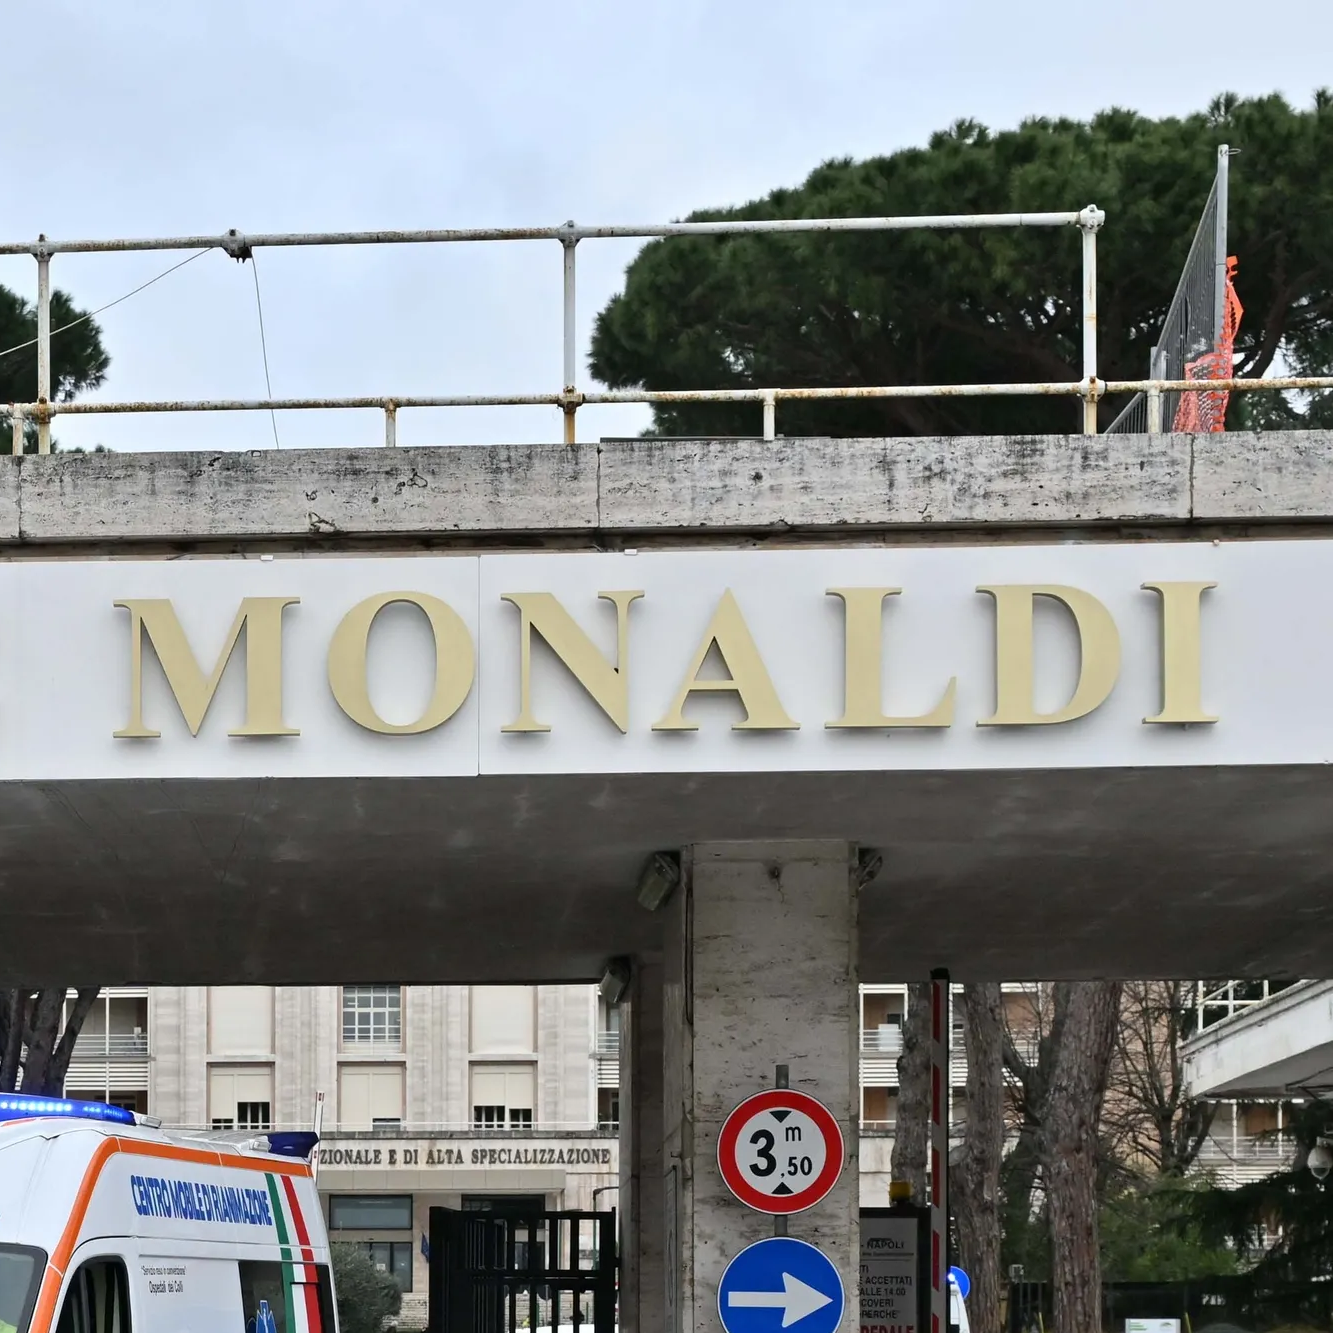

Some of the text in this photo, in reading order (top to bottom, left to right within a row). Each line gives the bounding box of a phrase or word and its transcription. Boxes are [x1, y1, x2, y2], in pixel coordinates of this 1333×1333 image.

[112, 581, 1220, 740] MONALDI
[785, 1126, 802, 1142] m
[319, 1148, 611, 1165] ZIONALE E DI ALTA SPECIALIZZAZIONE
[130, 1174, 172, 1218] CENTRO
[168, 1180, 206, 1221] MOBILE
[211, 1184, 273, 1226] RIANIMAZIONE
[867, 1241, 904, 1249] NAPOLI
[865, 1276, 913, 1286] ACCETTATI
[860, 1298, 894, 1307] COVERI
